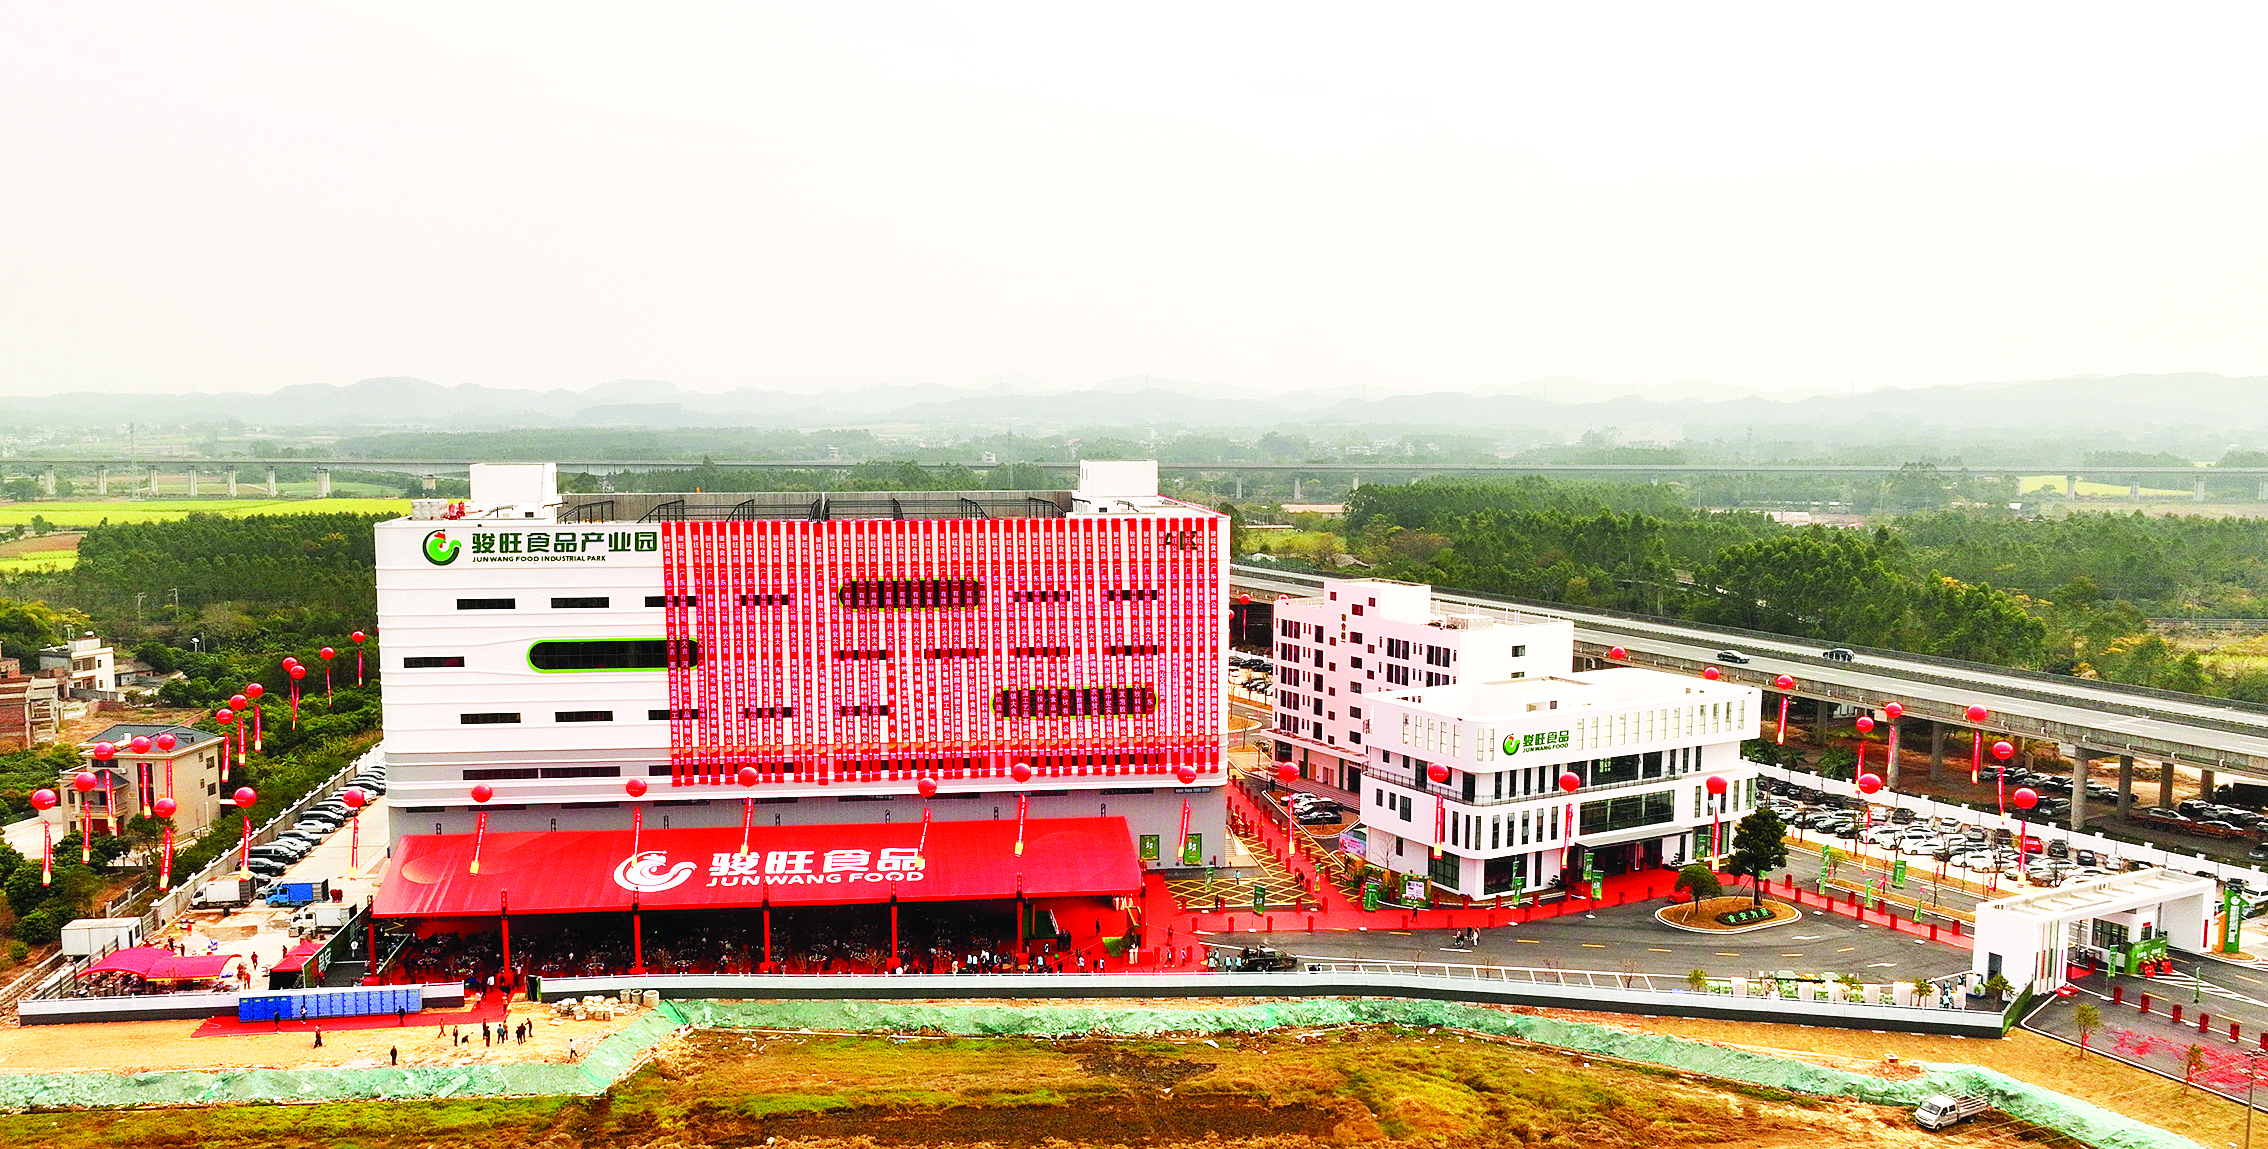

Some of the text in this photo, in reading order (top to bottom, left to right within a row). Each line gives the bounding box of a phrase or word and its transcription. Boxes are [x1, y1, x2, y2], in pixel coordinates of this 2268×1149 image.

[472, 532, 657, 553] 骏旺食品产业园
[1523, 730, 1569, 747] 骏旺食品
[708, 848, 926, 876] 骏旺食品
[848, 872, 925, 883] FOOD
